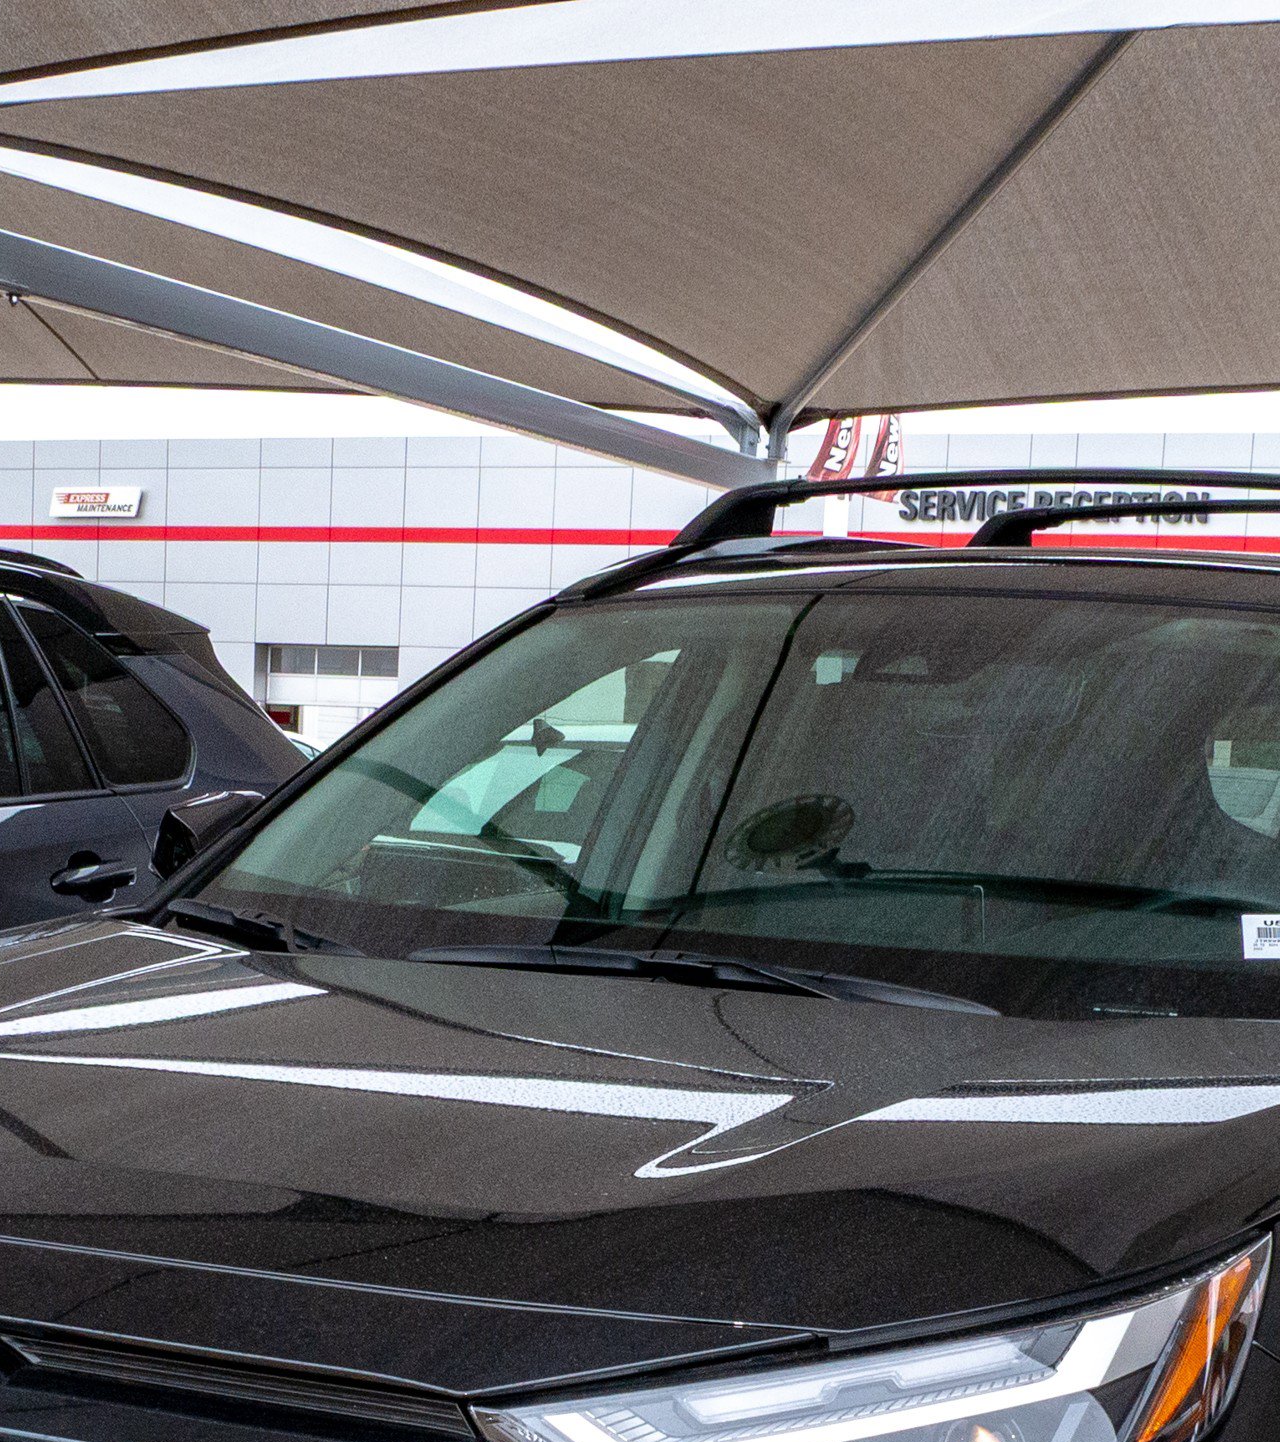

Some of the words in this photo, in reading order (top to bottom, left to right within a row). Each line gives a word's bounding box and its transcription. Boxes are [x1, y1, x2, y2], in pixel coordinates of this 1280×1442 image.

[69, 494, 107, 503] EXPRESS
[77, 504, 133, 512] MAINTENANCE
[899, 490, 1026, 523] SERVICE
